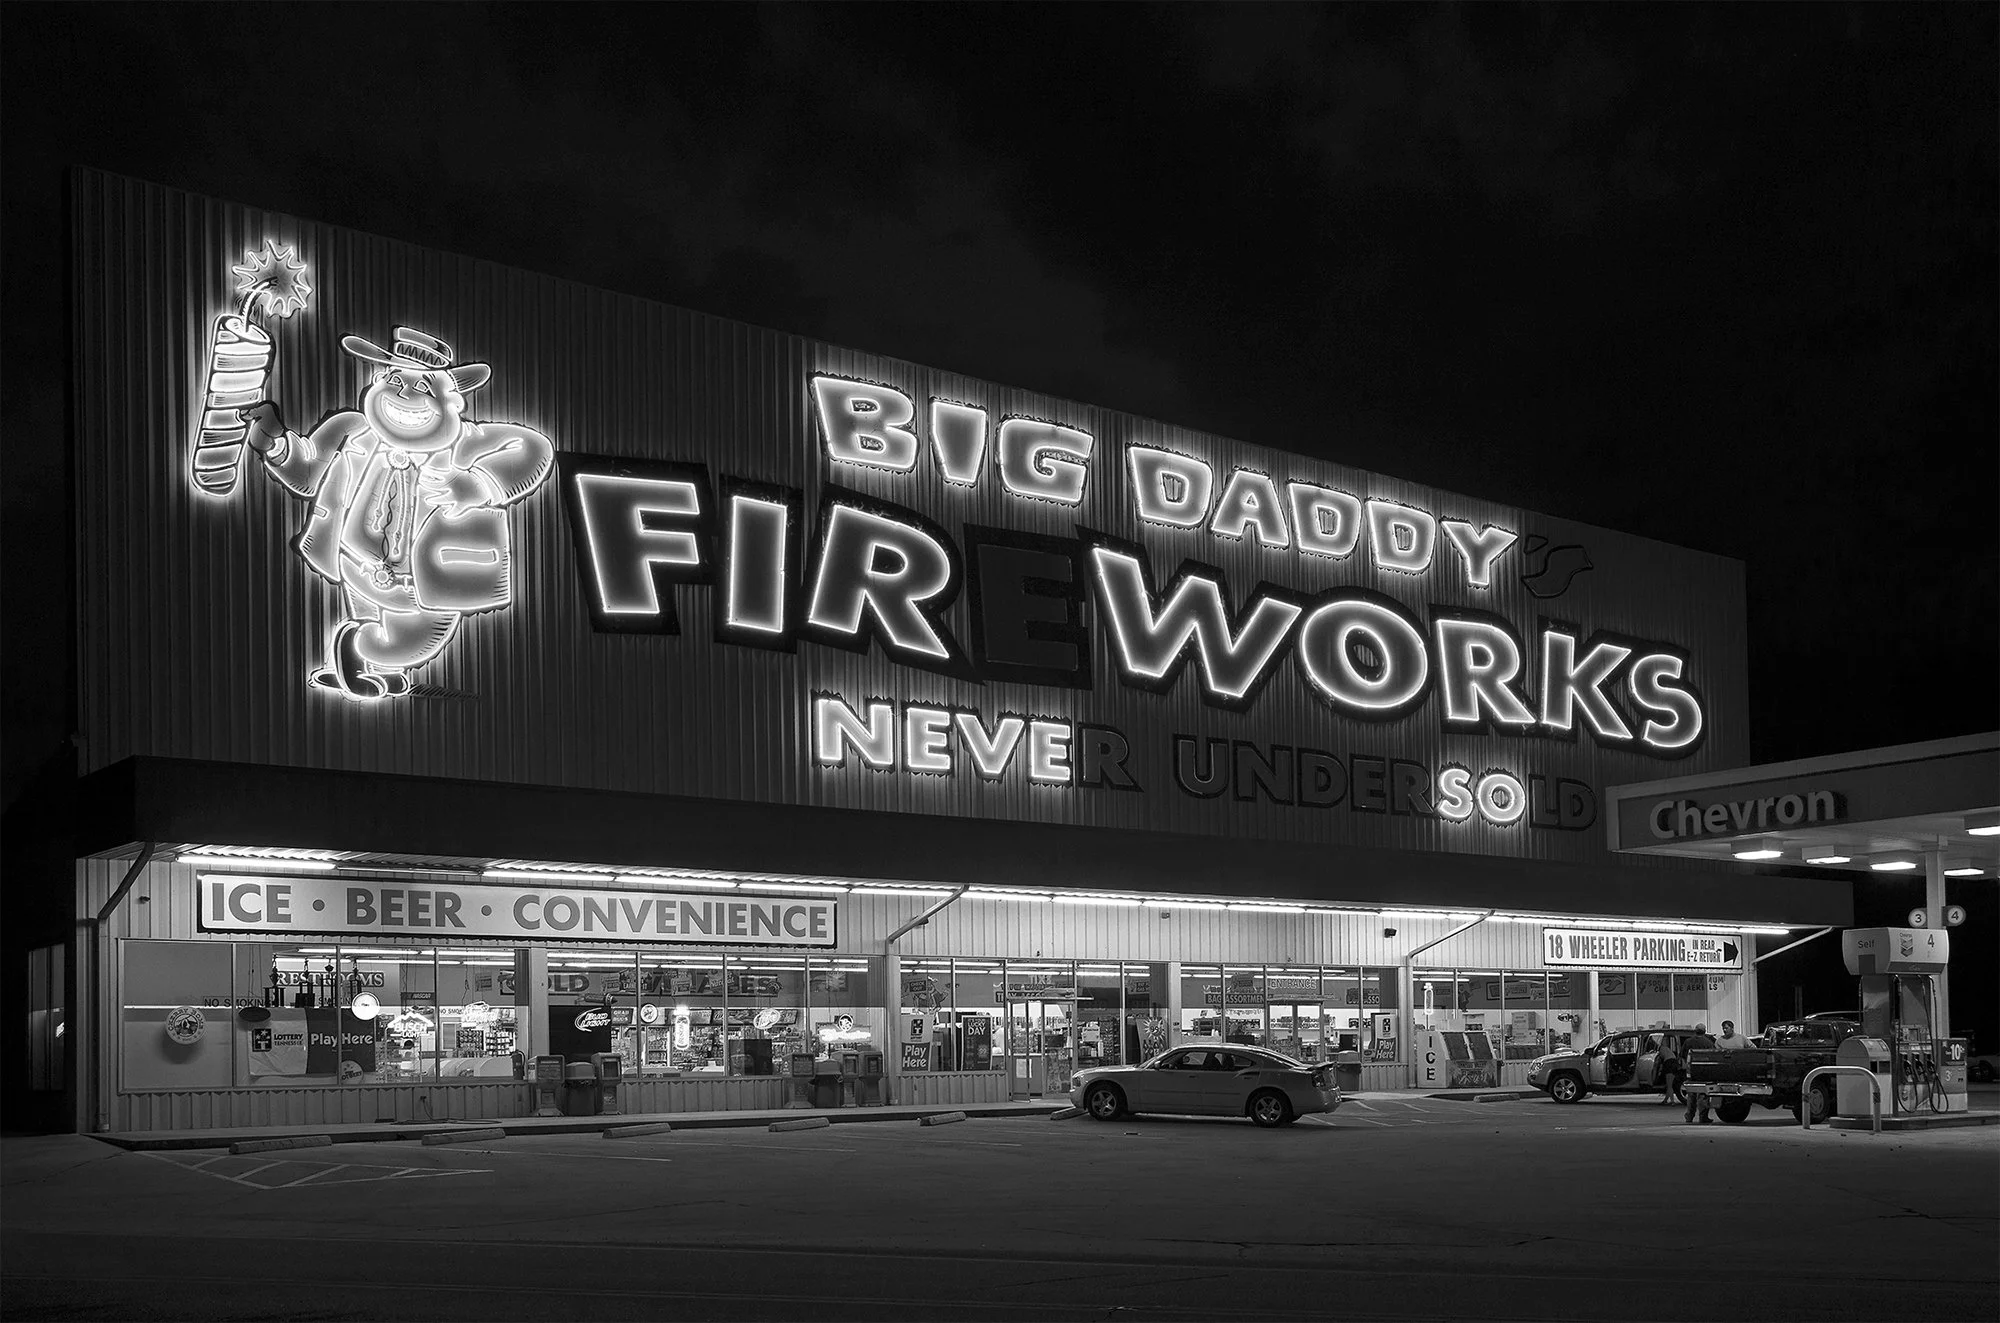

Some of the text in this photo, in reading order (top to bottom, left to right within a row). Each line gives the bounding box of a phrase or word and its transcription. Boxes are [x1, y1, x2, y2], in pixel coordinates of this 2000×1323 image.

[811, 376, 1518, 587] BIG DADDY
[576, 473, 1702, 748] FIREWORKS
[817, 698, 1596, 829] NEVER UNDERSOLD
[1650, 789, 1835, 839] Chevron
[211, 883, 828, 938] ICE BEER CONVENIENCE
[1951, 910, 1959, 920] 4
[1915, 913, 1922, 923] 3
[1692, 939, 1715, 951] IN REAR
[1857, 940, 1875, 949] Self
[1927, 933, 1935, 948] 4
[1549, 934, 1686, 962] 18 WHEELER PARKING
[1687, 950, 1721, 963] E-Z RETURN
[204, 998, 220, 1008] NO
[273, 1033, 304, 1041] LOTTERY
[968, 1026, 986, 1036] DAY
[310, 1032, 374, 1047] Play Here
[1379, 1040, 1395, 1051] Play
[904, 1045, 926, 1058] Play
[1376, 1049, 1394, 1059] Here
[1424, 1035, 1436, 1081] ICE
[902, 1056, 927, 1068] Here
